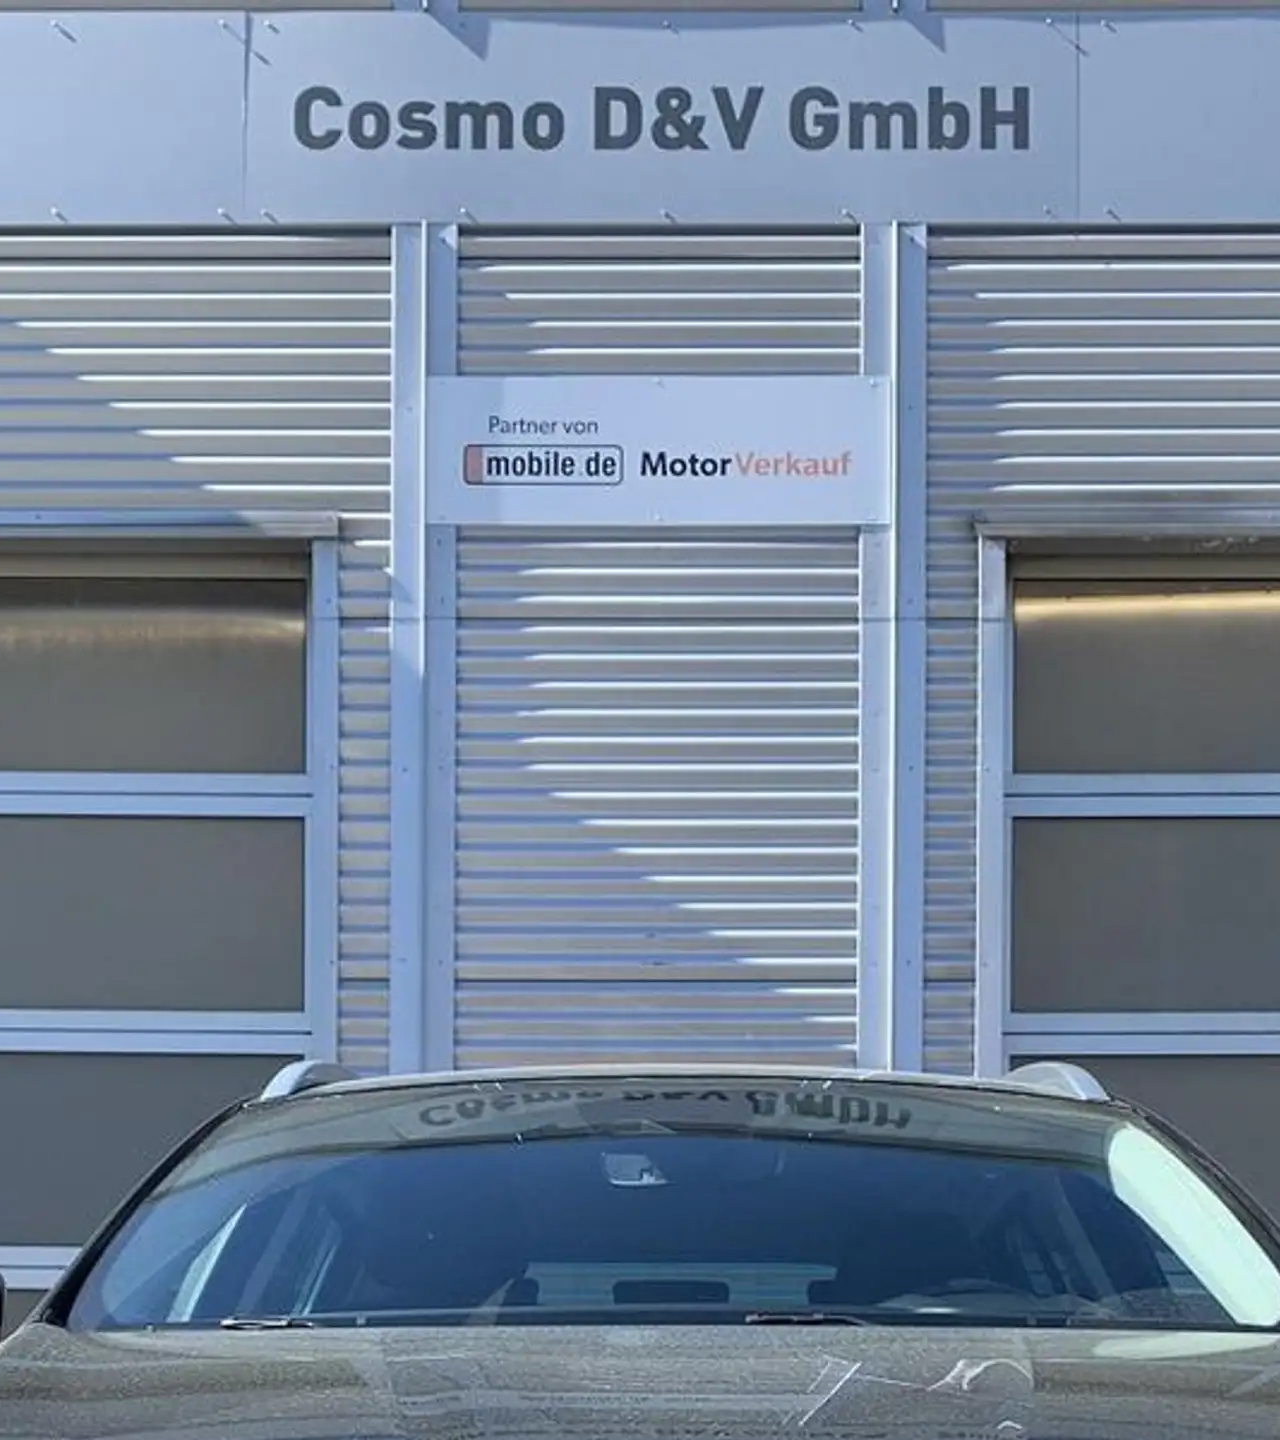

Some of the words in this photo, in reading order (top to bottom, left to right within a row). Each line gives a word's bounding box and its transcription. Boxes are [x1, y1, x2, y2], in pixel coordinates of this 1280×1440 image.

[294, 86, 565, 152] Cosmo
[593, 87, 764, 152] D&V
[789, 86, 1031, 152] GmbH
[488, 415, 558, 435] Partner
[563, 419, 598, 435] von
